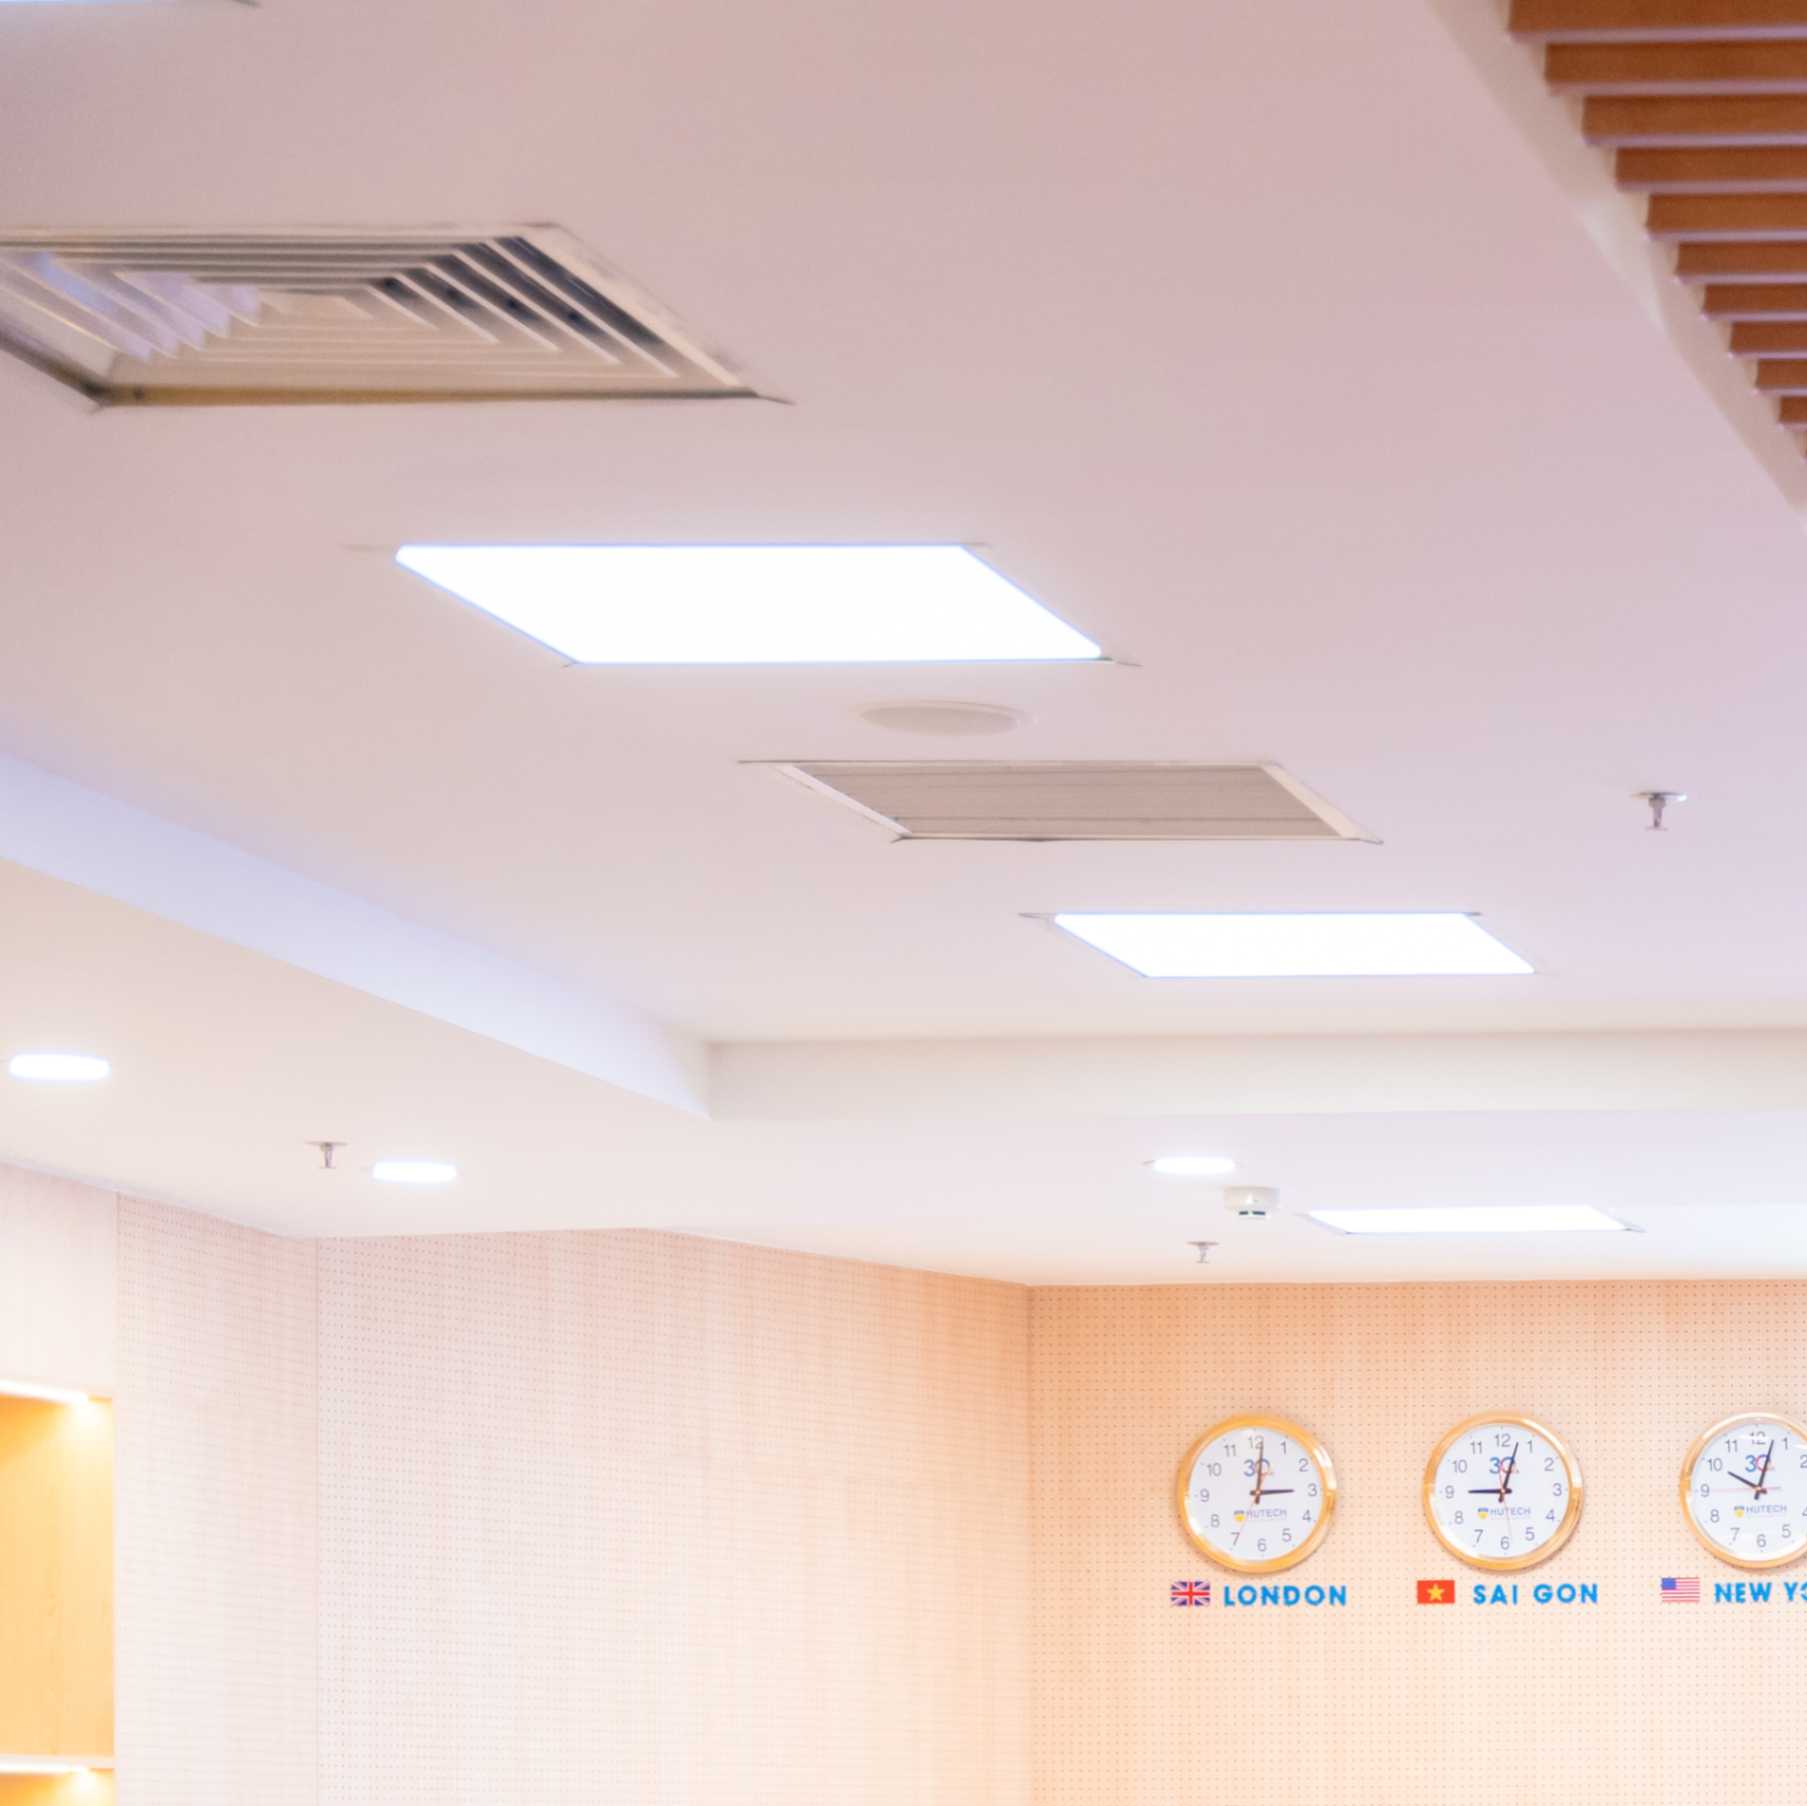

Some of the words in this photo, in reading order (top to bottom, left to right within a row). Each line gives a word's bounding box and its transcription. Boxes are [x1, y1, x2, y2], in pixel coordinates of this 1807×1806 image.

[1494, 1433, 1511, 1447] 12
[1528, 1440, 1533, 1452] 1
[1725, 1440, 1738, 1452] 11
[1782, 1438, 1788, 1450] 1
[1224, 1444, 1237, 1457] 11
[1282, 1442, 1287, 1454] 1
[1470, 1442, 1482, 1454] 11
[1207, 1463, 1222, 1477] 10
[1298, 1458, 1308, 1472] 2
[1453, 1460, 1468, 1473] 10
[1544, 1458, 1554, 1471] 2
[1708, 1458, 1723, 1472] 10
[1200, 1489, 1210, 1502] 9
[1308, 1483, 1318, 1497] 3
[1445, 1486, 1454, 1499] 9
[1552, 1483, 1562, 1496] 3
[1700, 1483, 1710, 1497] 9
[1211, 1514, 1220, 1528] 8
[1302, 1510, 1311, 1522] 4
[1454, 1511, 1464, 1524] 8
[1545, 1510, 1555, 1521] 4
[1710, 1509, 1720, 1523] 8
[1282, 1528, 1291, 1542] 5
[1474, 1529, 1484, 1544] 7
[1525, 1527, 1535, 1541] 5
[1730, 1528, 1740, 1541] 7
[1782, 1524, 1791, 1538] 5
[1231, 1532, 1240, 1546] 7
[1257, 1538, 1267, 1552] 6
[1501, 1536, 1510, 1550] 6
[1757, 1534, 1767, 1548] 6
[1224, 1585, 1346, 1607] LONDON
[1473, 1584, 1518, 1606] SAI
[1532, 1583, 1599, 1605] GON
[1714, 1582, 1773, 1604] NEW
